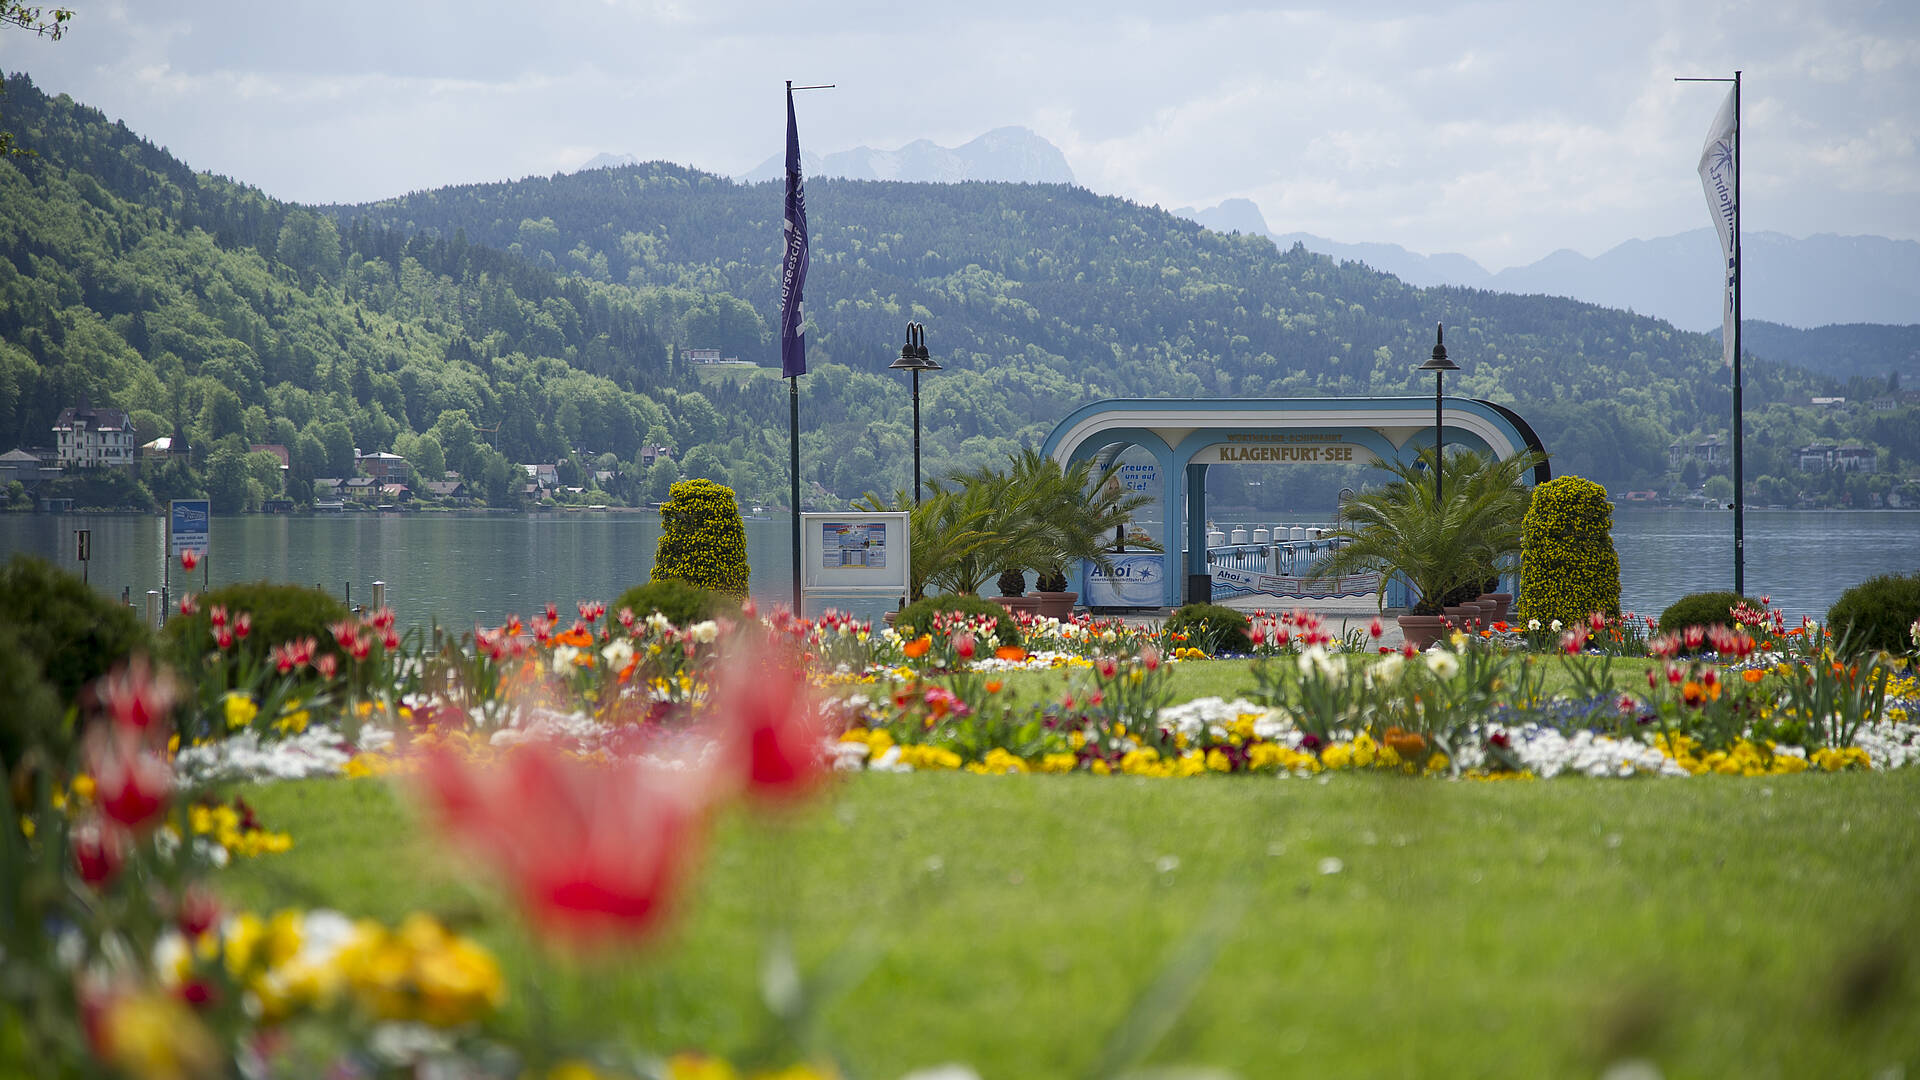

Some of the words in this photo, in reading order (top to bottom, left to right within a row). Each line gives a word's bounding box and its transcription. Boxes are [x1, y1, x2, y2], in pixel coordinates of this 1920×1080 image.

[1220, 447, 1353, 461] KLAGENFURT-SEE
[1127, 482, 1147, 491] Sie!
[1217, 570, 1241, 581] Ahoi
